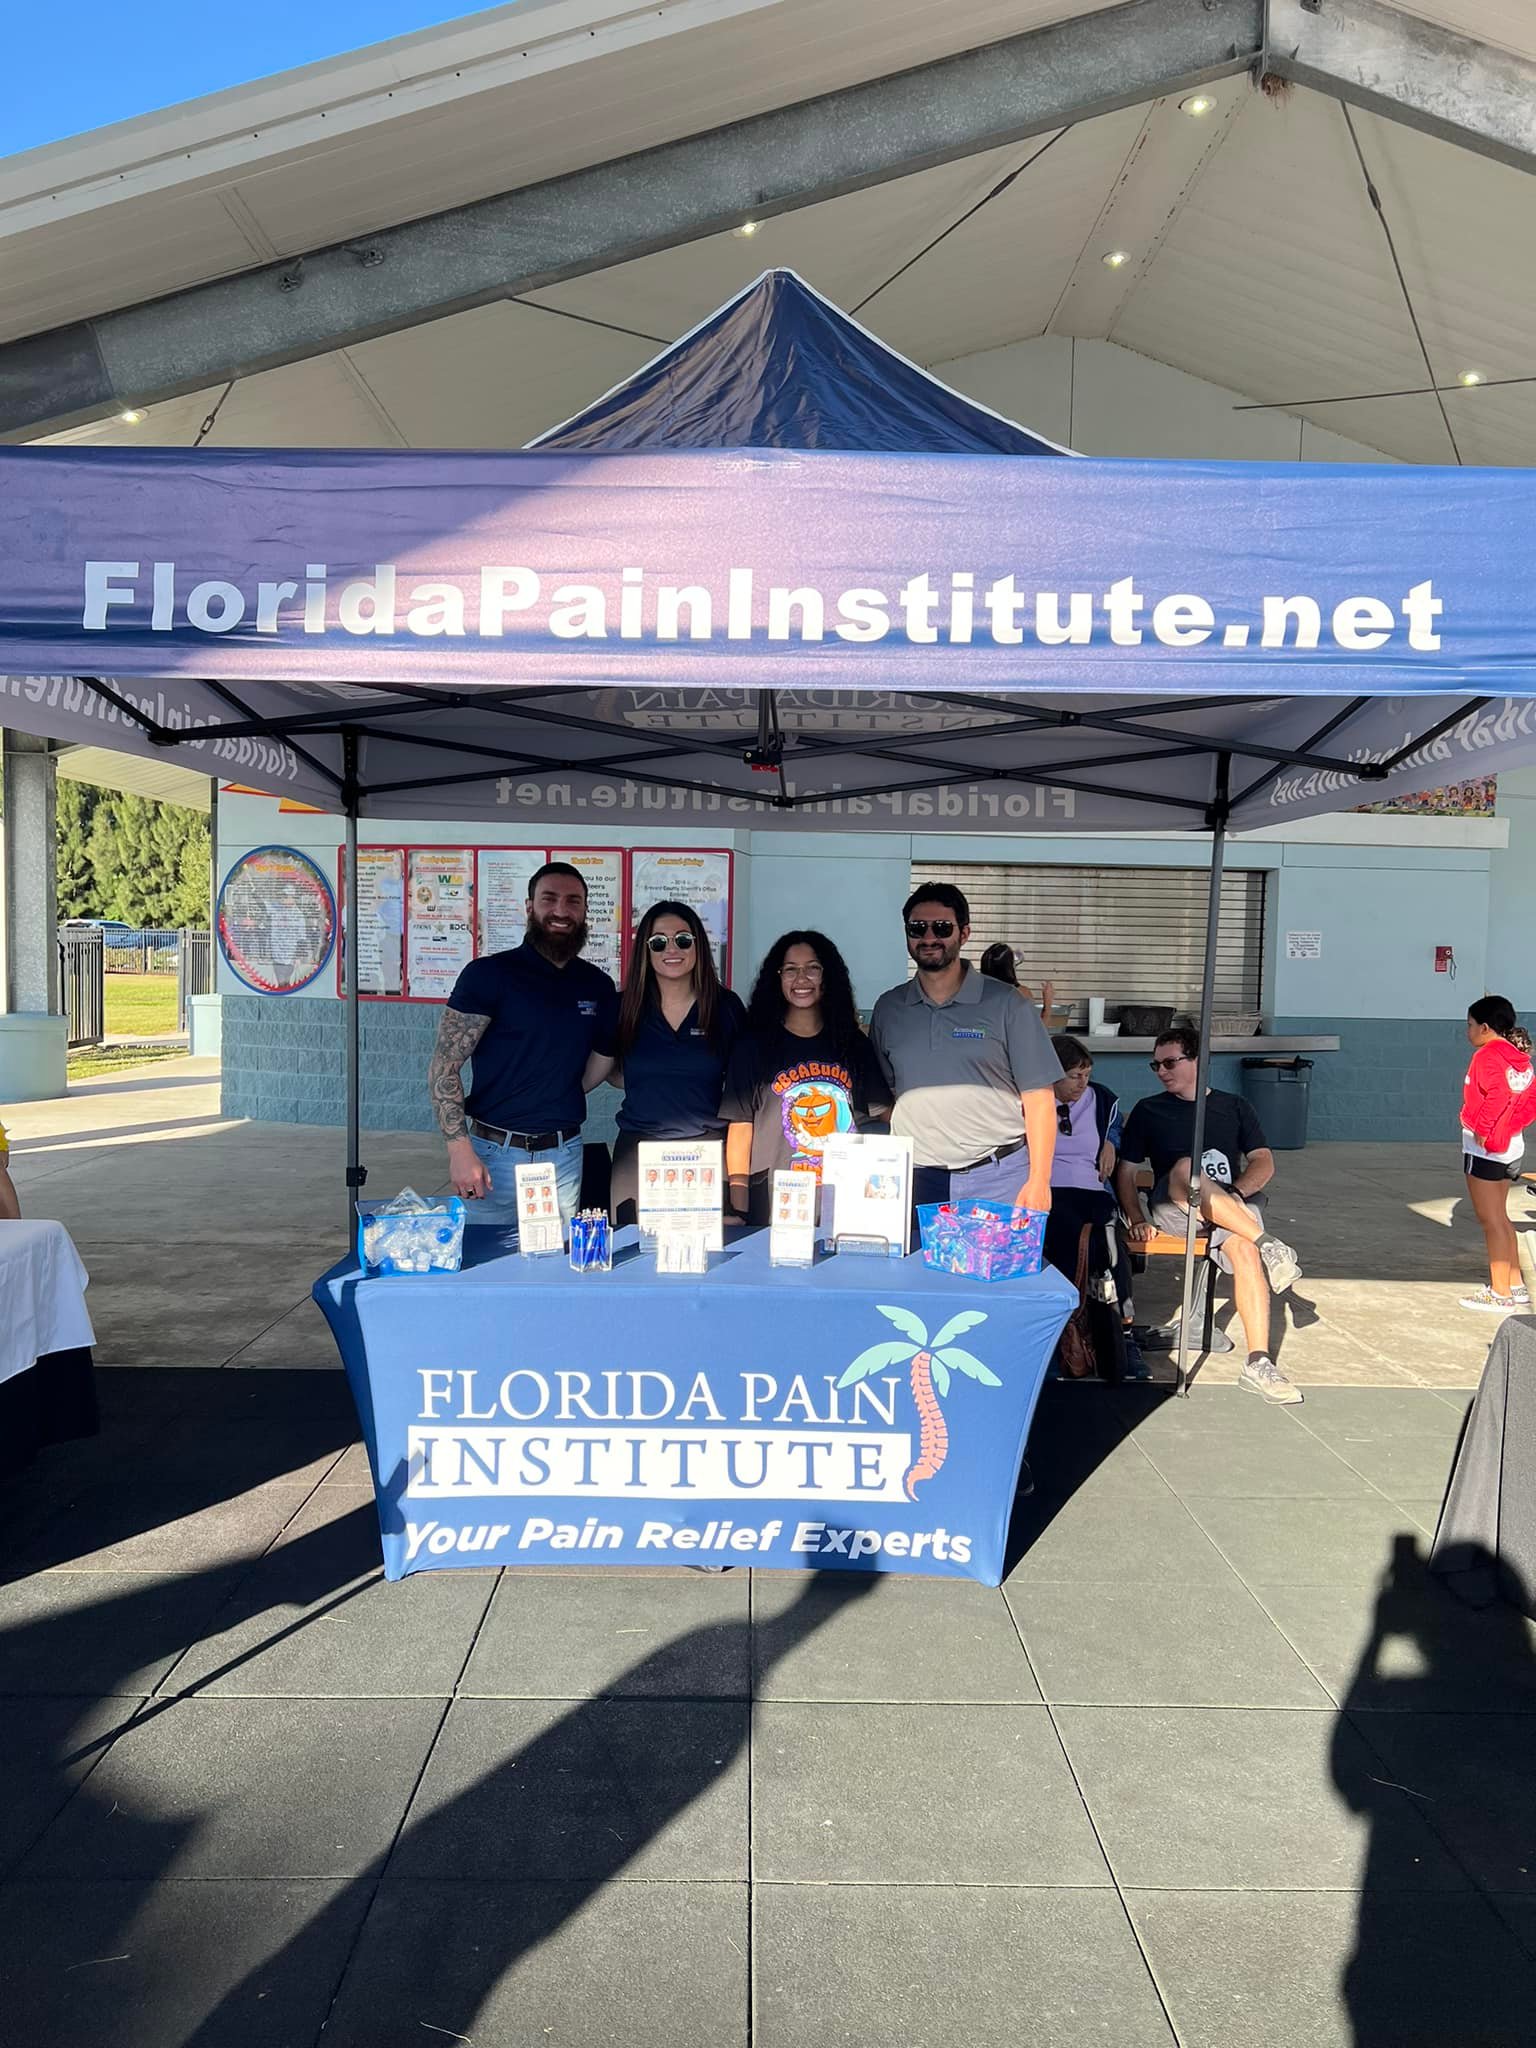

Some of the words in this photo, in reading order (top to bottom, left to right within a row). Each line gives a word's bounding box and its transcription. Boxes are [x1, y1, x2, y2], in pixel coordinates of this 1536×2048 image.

[83, 561, 1443, 651] FloridaPainInstitute.net
[417, 1369, 727, 1421] FLORIDA
[740, 1373, 902, 1426] PAIN
[418, 1437, 887, 1491] INSTITUTE
[405, 1521, 511, 1560] Your
[518, 1517, 625, 1549] Pain
[636, 1520, 783, 1552] Relief
[791, 1522, 973, 1563] Experts
